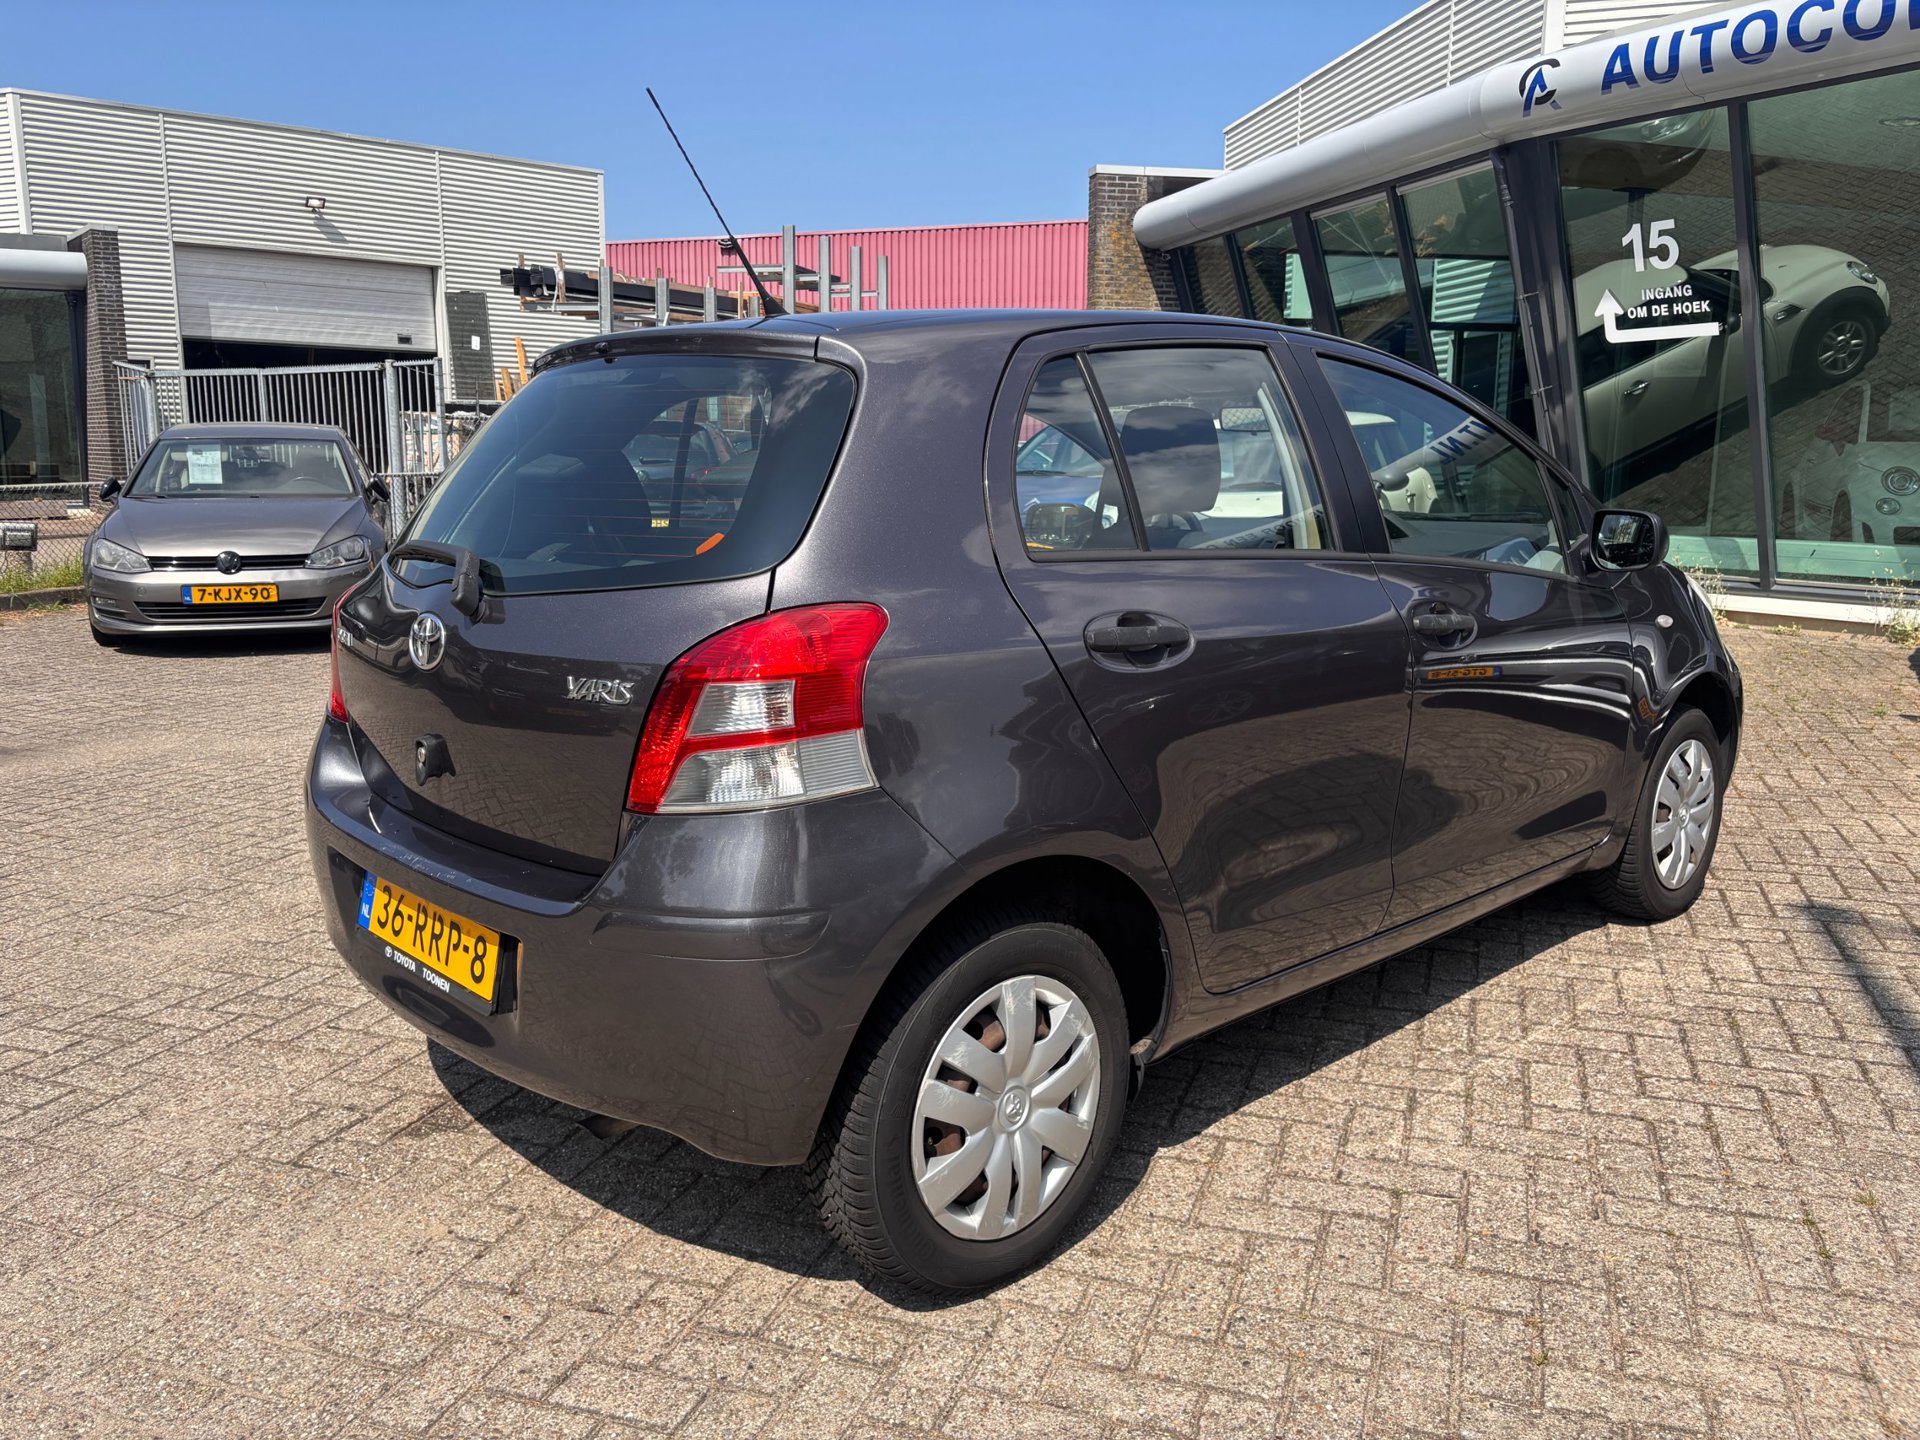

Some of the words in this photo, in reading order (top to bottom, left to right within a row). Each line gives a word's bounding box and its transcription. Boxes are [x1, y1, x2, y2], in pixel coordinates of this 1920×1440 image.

[1601, 0, 1920, 96] AUTOCO
[1622, 219, 1679, 272] 15
[1627, 305, 1648, 319] OM
[1651, 304, 1669, 317] DE
[1673, 300, 1711, 315] HOEK
[1641, 284, 1693, 301] INGANG
[197, 587, 271, 602] 7-KJX-90
[361, 902, 370, 919] NL
[377, 885, 488, 984] 36-RRP-8
[393, 950, 417, 973] TOYOTA
[422, 967, 451, 993] TOONEN
